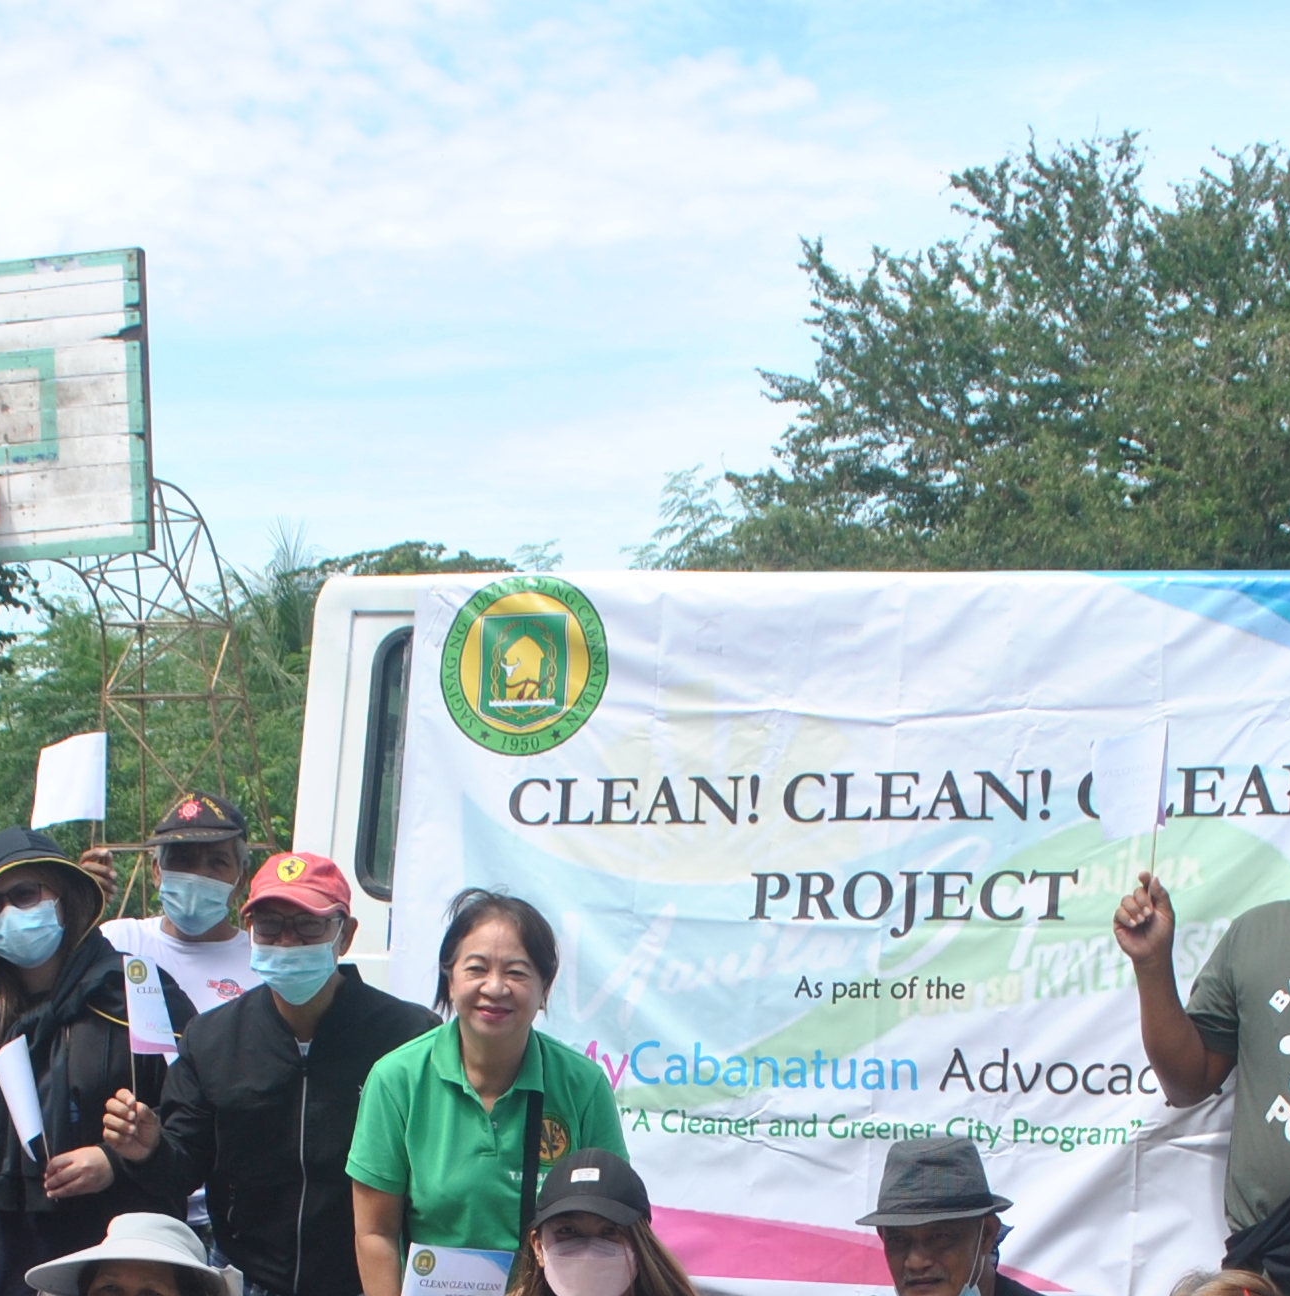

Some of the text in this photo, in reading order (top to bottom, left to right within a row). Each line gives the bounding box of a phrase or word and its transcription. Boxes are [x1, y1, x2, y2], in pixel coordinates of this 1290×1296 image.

[553, 585, 577, 606] NG
[565, 604, 604, 728] CABANATUAN
[500, 735, 540, 751] 1950
[508, 774, 760, 826] CLEAN!
[782, 769, 1051, 823] CLEAN!
[748, 868, 1078, 938] PROJECT
[794, 975, 966, 1005] As part of the
[660, 1109, 760, 1135] Cleaner
[769, 1113, 817, 1138] and
[828, 1113, 937, 1141] Greener
[945, 1116, 1002, 1149] City
[419, 1279, 502, 1292] CLEAN! CLEAN! CLEAN!
